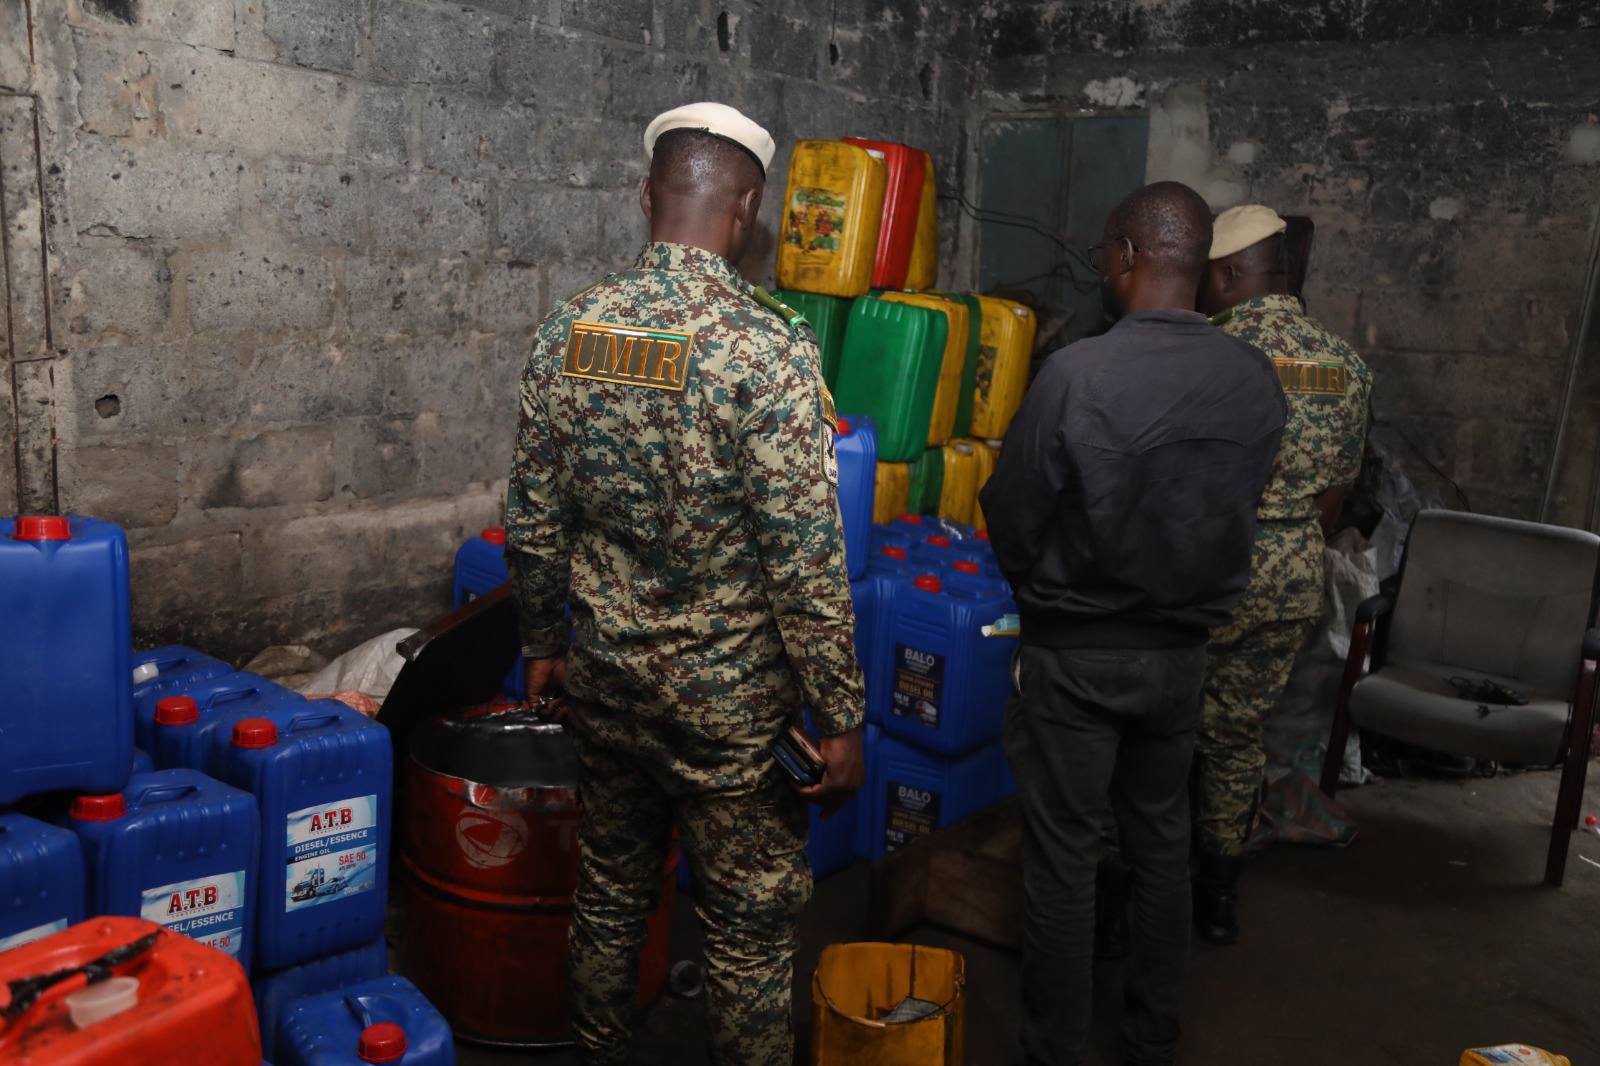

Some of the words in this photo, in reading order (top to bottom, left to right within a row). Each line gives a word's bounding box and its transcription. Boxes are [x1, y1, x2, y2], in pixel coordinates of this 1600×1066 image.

[573, 331, 682, 383] UMIR
[904, 648, 935, 667] BALO
[898, 785, 931, 803] BALO
[310, 808, 352, 832] A.T.B
[295, 830, 368, 853] DIESEL/ESSENCE
[339, 853, 354, 865] SAE
[169, 886, 217, 913] A.T.B
[220, 936, 230, 947] 50
